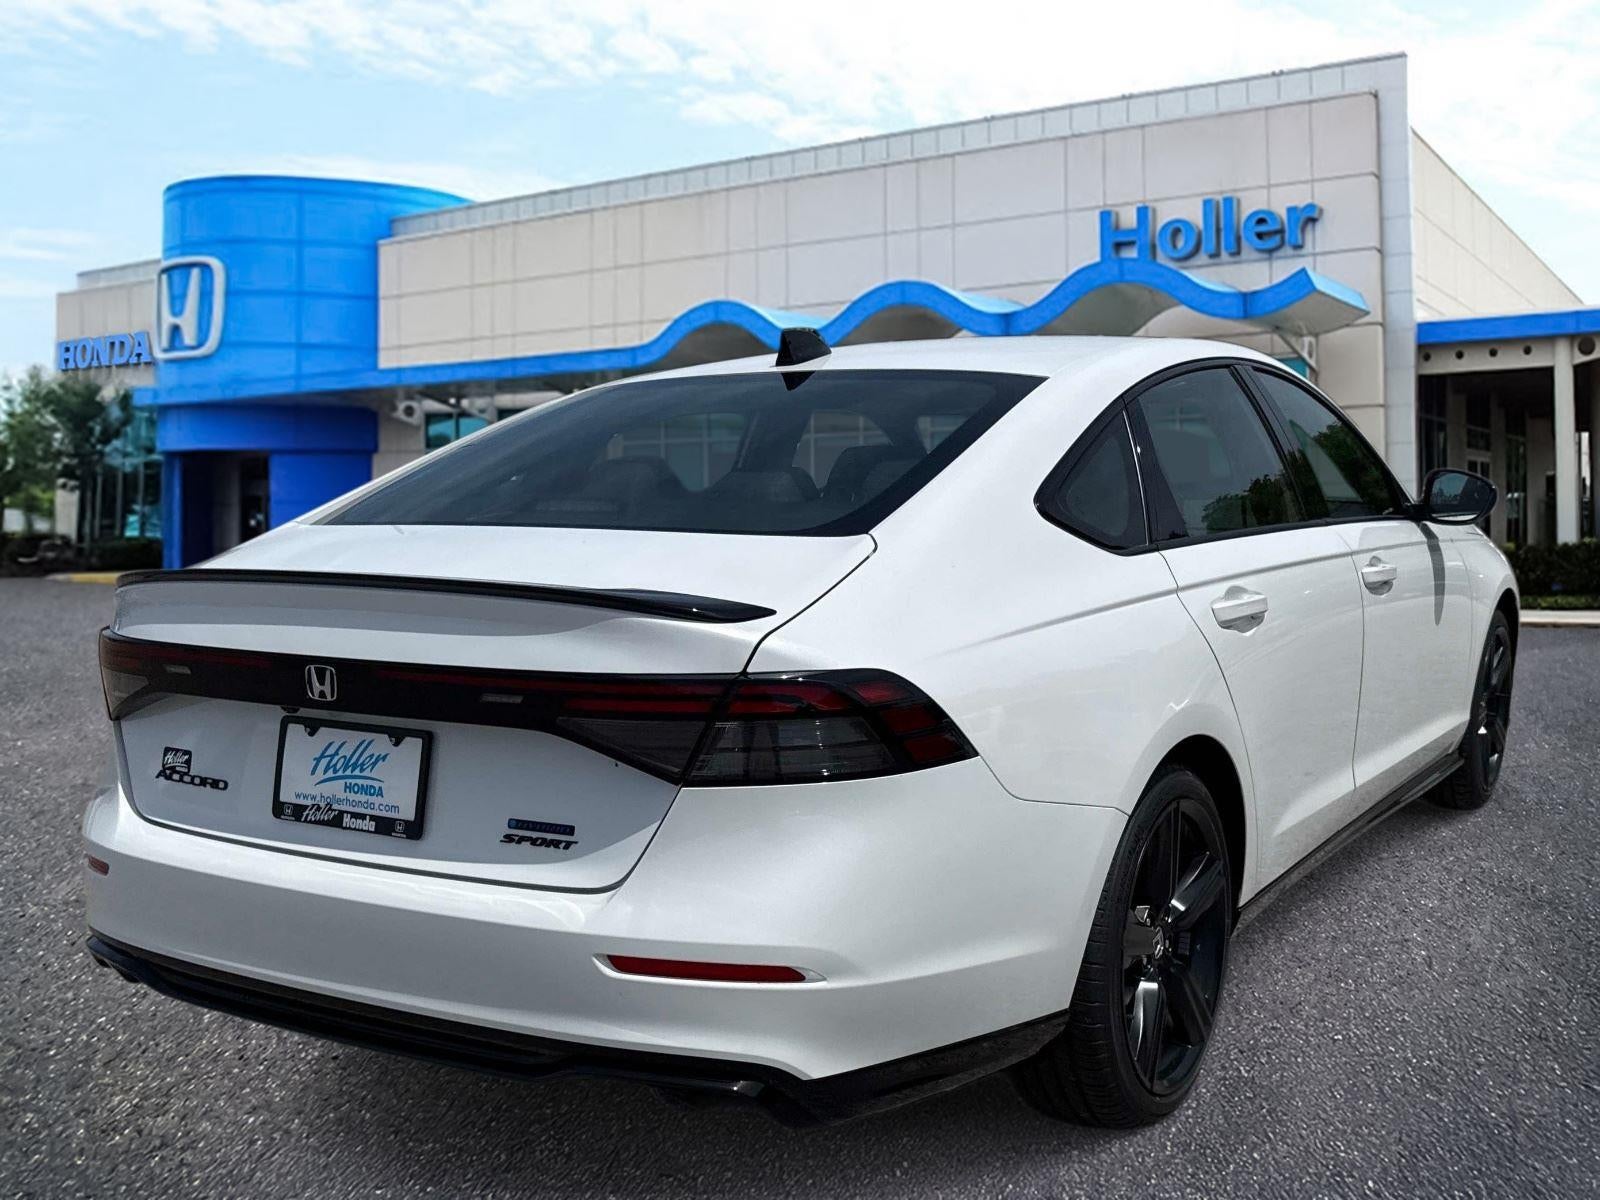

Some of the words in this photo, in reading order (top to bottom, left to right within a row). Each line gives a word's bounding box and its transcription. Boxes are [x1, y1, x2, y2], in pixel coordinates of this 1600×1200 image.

[1098, 195, 1322, 262] Holler
[57, 331, 152, 371] HONDA
[310, 738, 390, 776] Holler
[155, 769, 228, 791] ACCORD
[344, 781, 384, 798] HONDA
[294, 791, 400, 814] www.hollerhonda.com
[301, 804, 338, 821] Holler
[342, 813, 376, 831] Honda
[499, 833, 579, 850] SPORT
